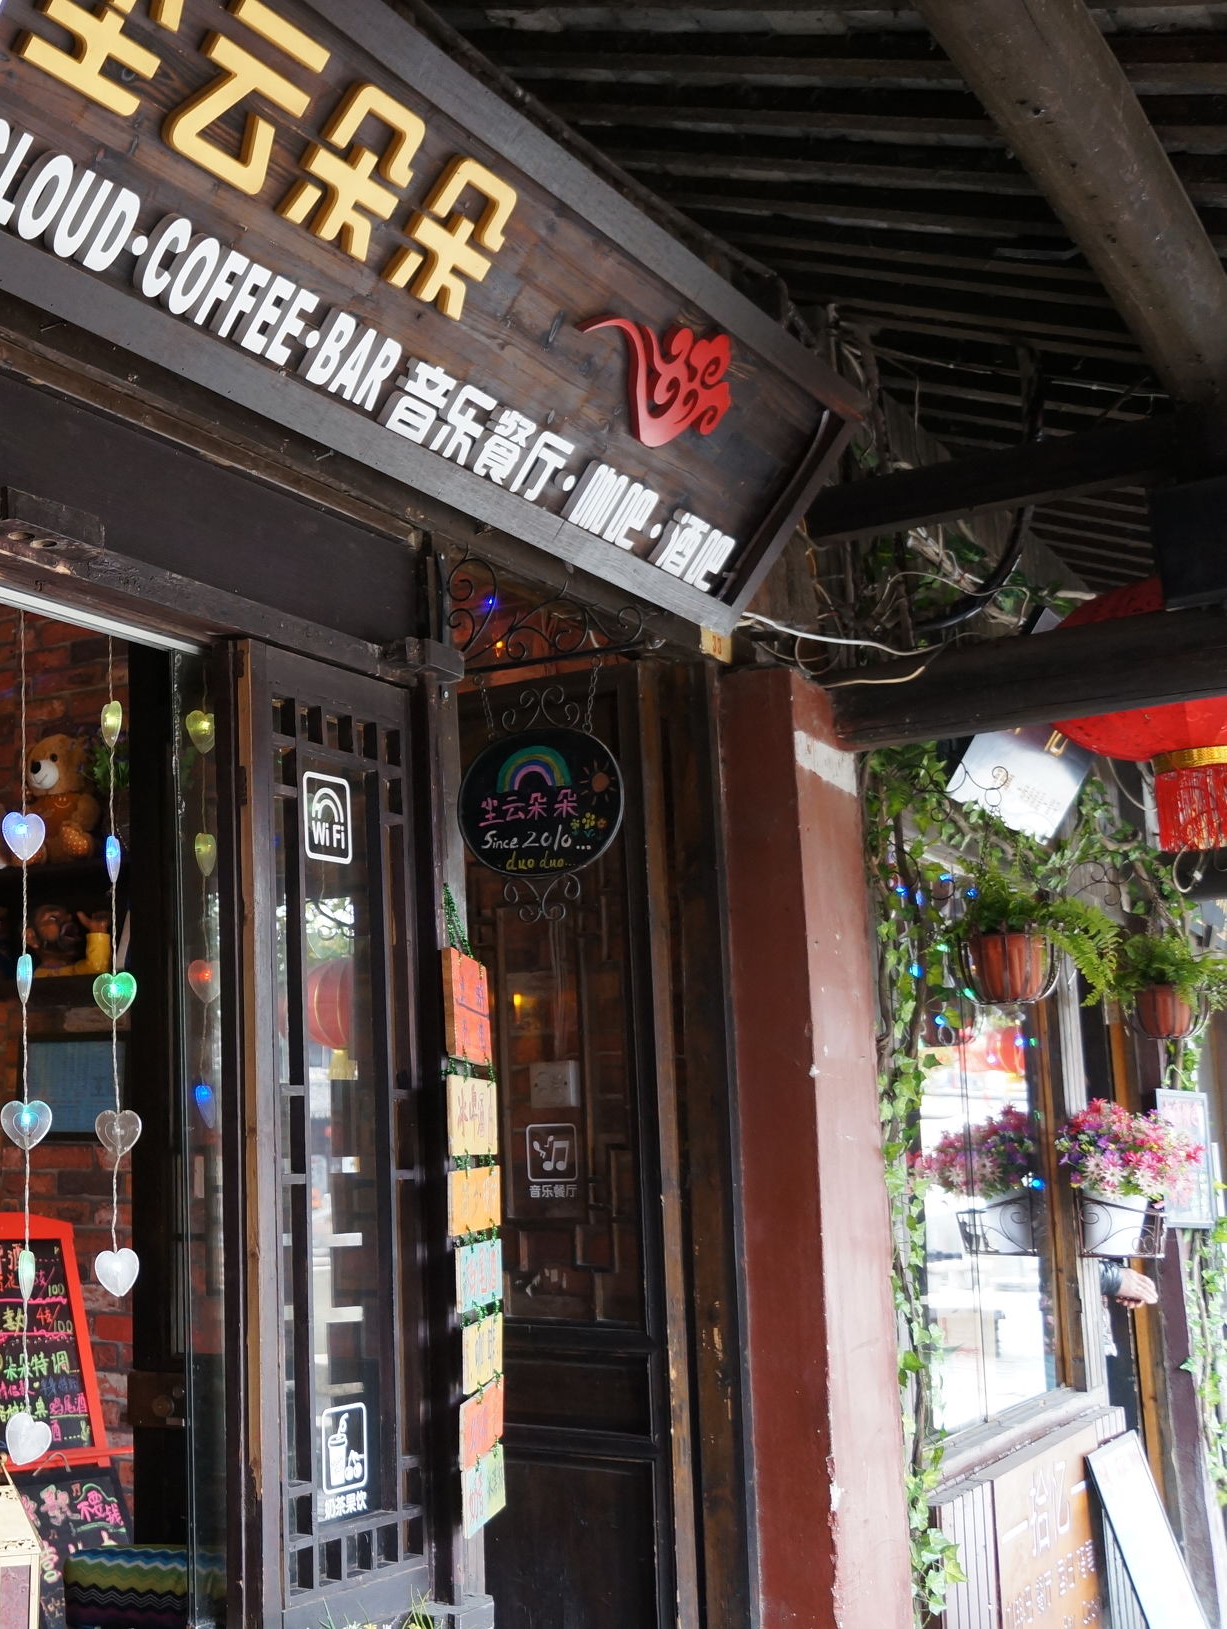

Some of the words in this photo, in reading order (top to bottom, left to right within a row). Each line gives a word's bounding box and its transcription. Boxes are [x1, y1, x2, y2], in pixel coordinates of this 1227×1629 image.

[140, 217, 320, 363] COFFEE
[305, 311, 402, 411] BAR
[478, 788, 579, 827] 尘云朵朵
[481, 829, 519, 849] Since
[505, 850, 535, 871] duo
[529, 1184, 578, 1198] 音乐餐厅
[324, 1490, 367, 1519] 奶茶果饮
